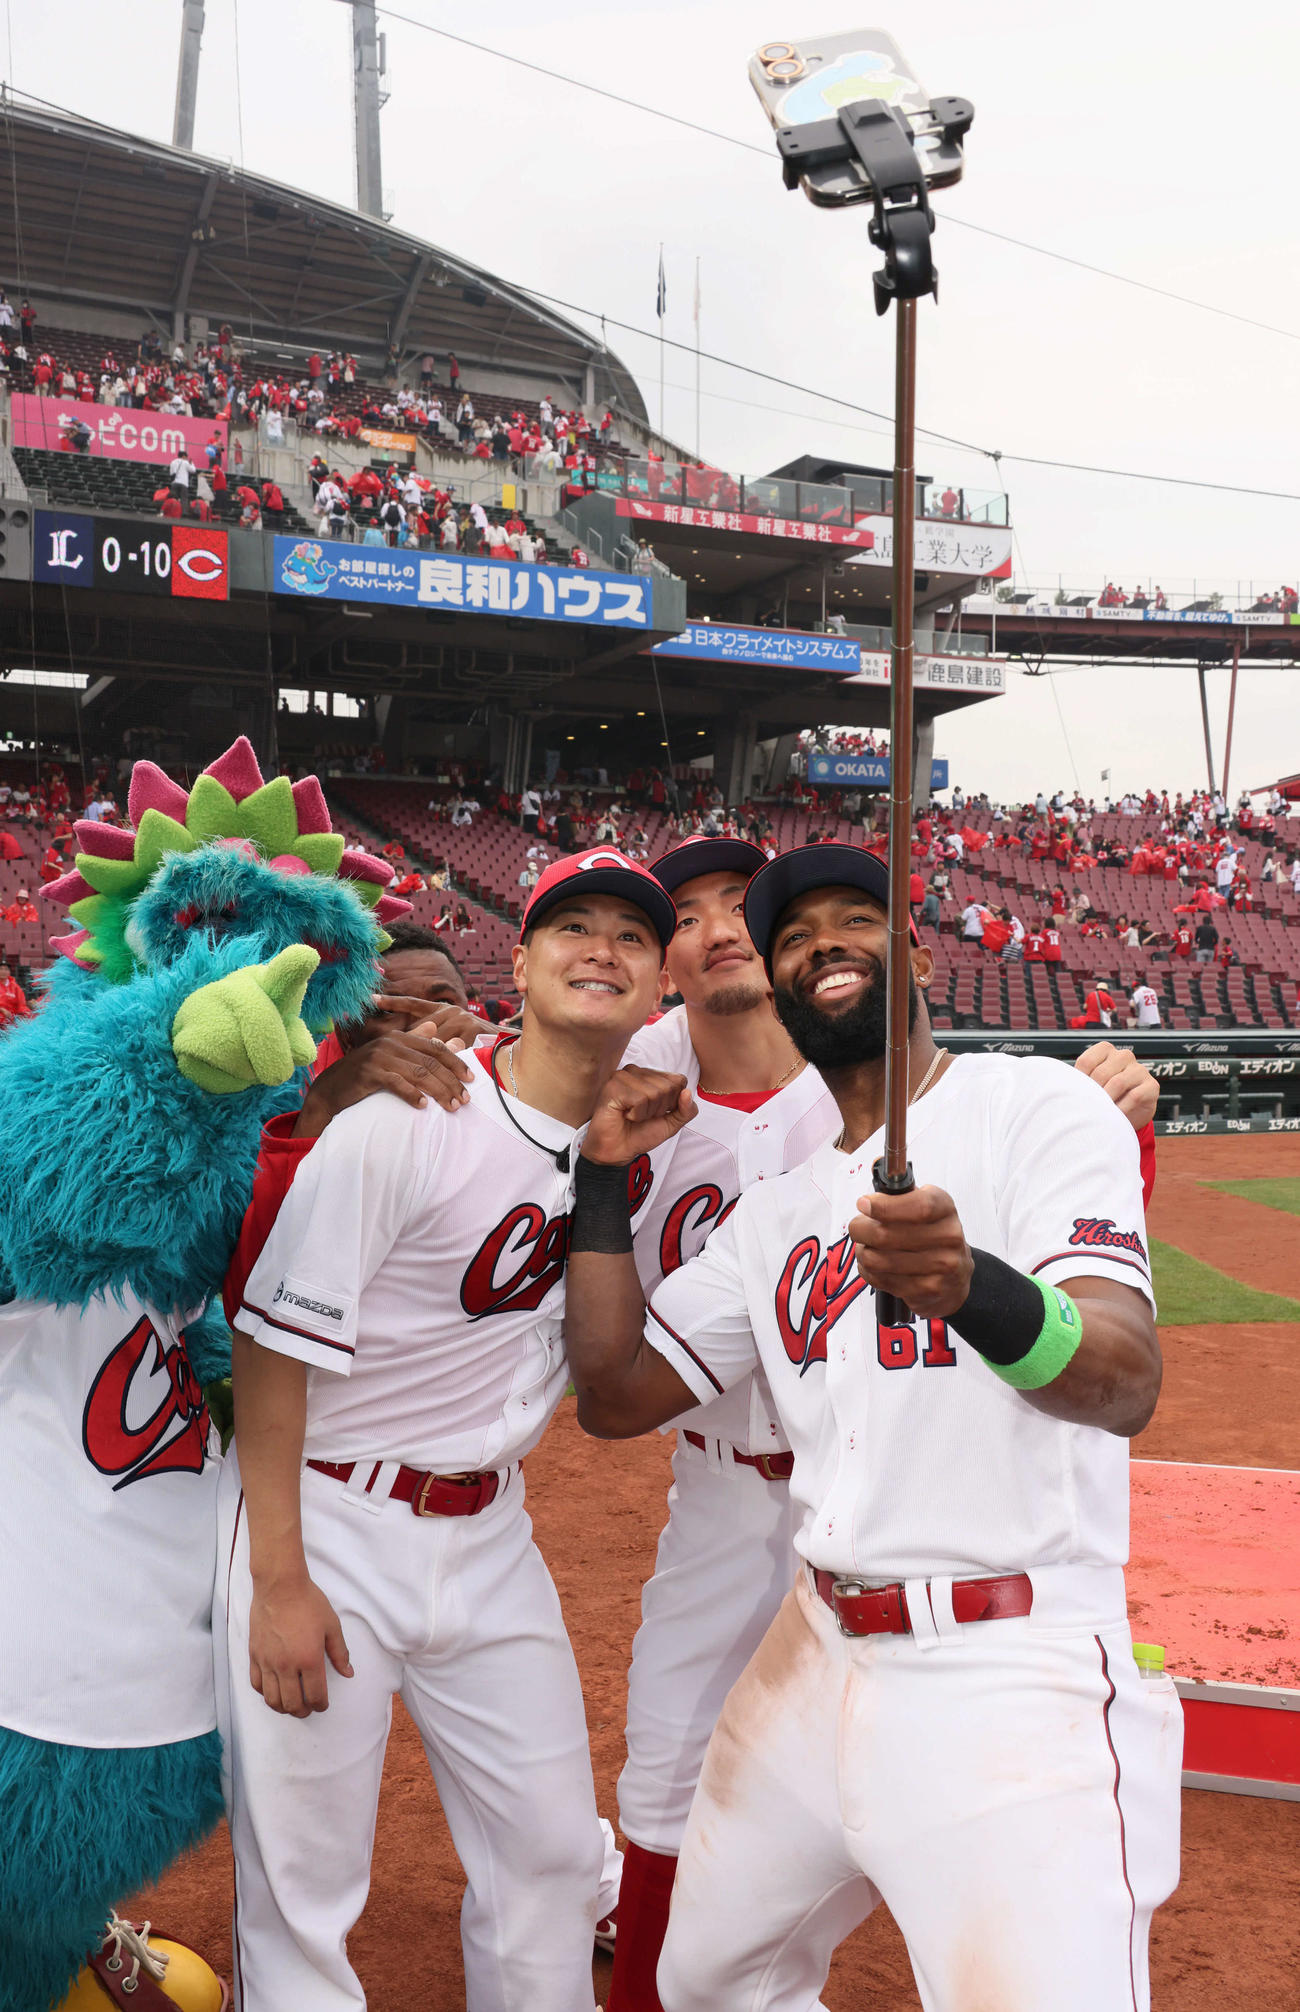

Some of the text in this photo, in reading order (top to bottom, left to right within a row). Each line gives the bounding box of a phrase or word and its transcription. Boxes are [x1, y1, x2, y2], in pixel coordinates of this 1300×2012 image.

[417, 559, 647, 624] 良和ハウス
[695, 629, 859, 660] 日本クライメイトシステムズ
[927, 662, 1002, 687] 鹿島建設
[835, 762, 886, 778] OKATA
[1240, 1059, 1295, 1074] エディオン
[1165, 1120, 1208, 1134] エディオン
[283, 1290, 345, 1321] mazda
[876, 1310, 957, 1371] 61
